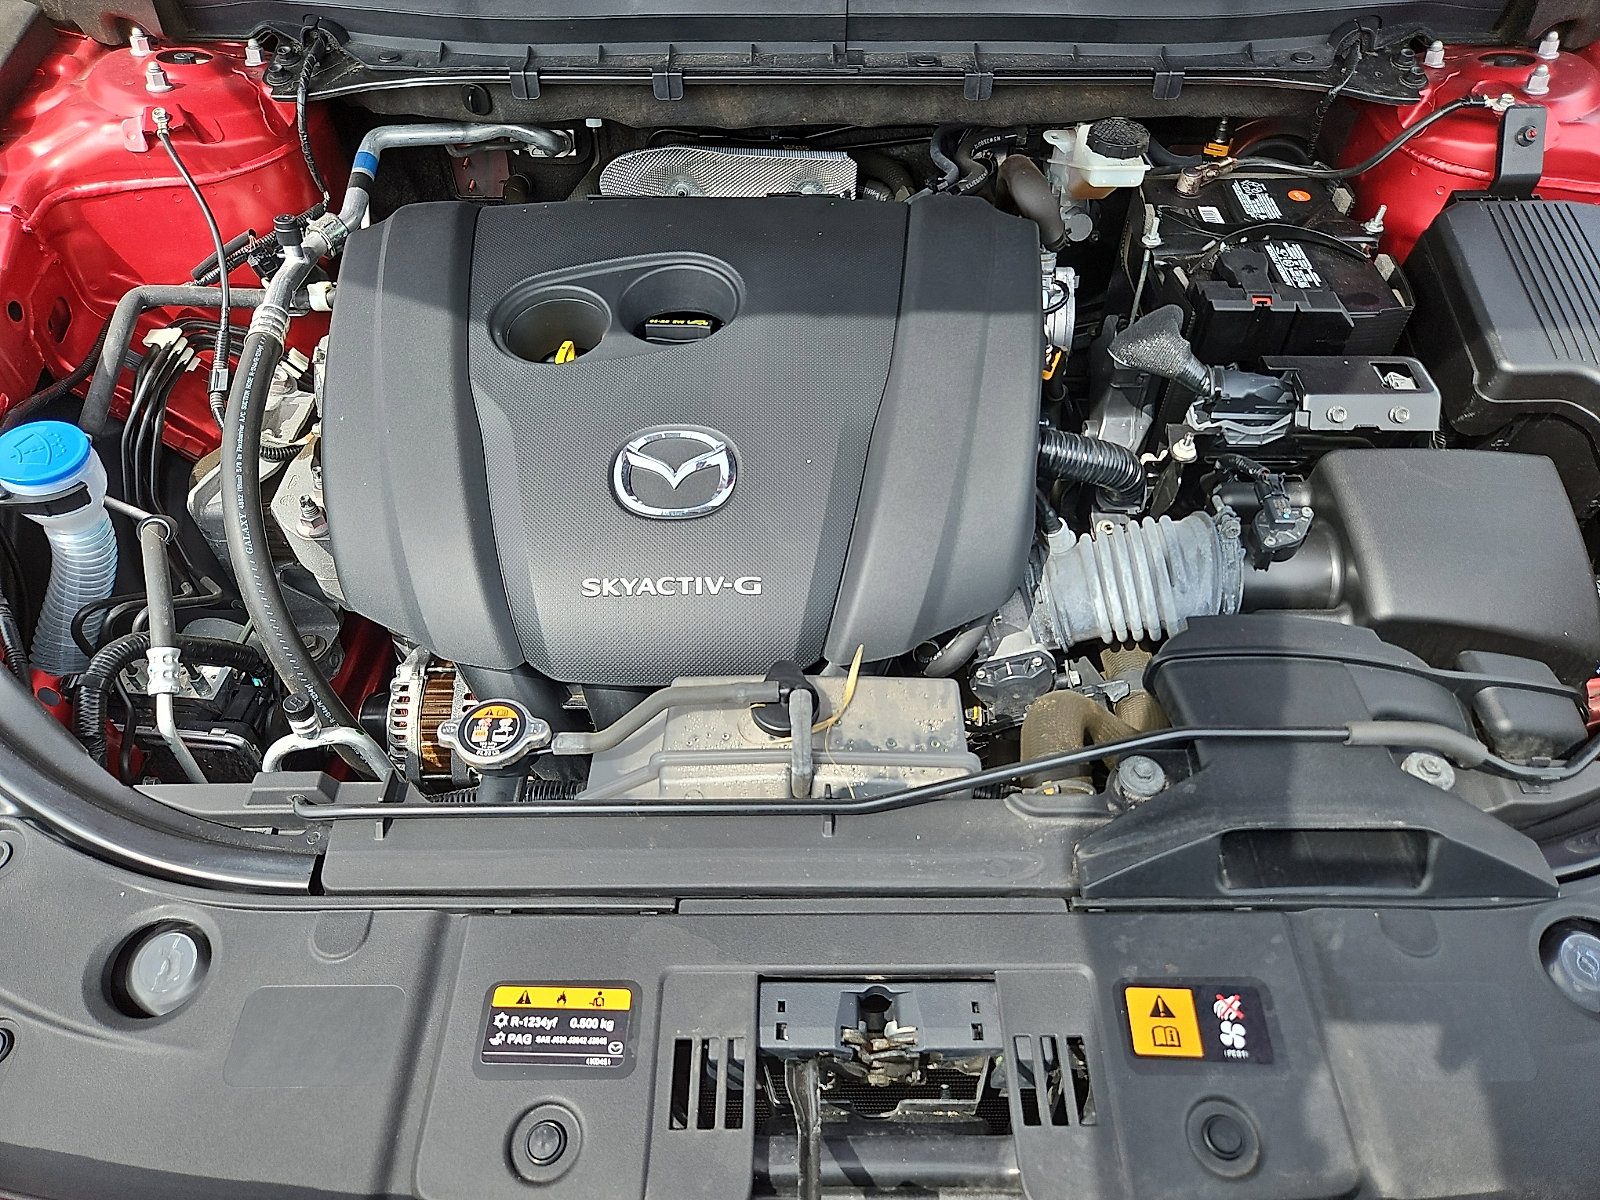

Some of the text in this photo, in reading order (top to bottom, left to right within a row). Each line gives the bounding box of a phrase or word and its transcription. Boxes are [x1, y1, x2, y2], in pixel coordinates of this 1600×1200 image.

[240, 389, 251, 411] SUCTION
[239, 411, 247, 423] A/C
[239, 512, 253, 554] GALAXY
[581, 576, 762, 597] SKYACTIV-G
[510, 1016, 616, 1032] R-1234yf 0.500 kg
[506, 1033, 533, 1046] PAG
